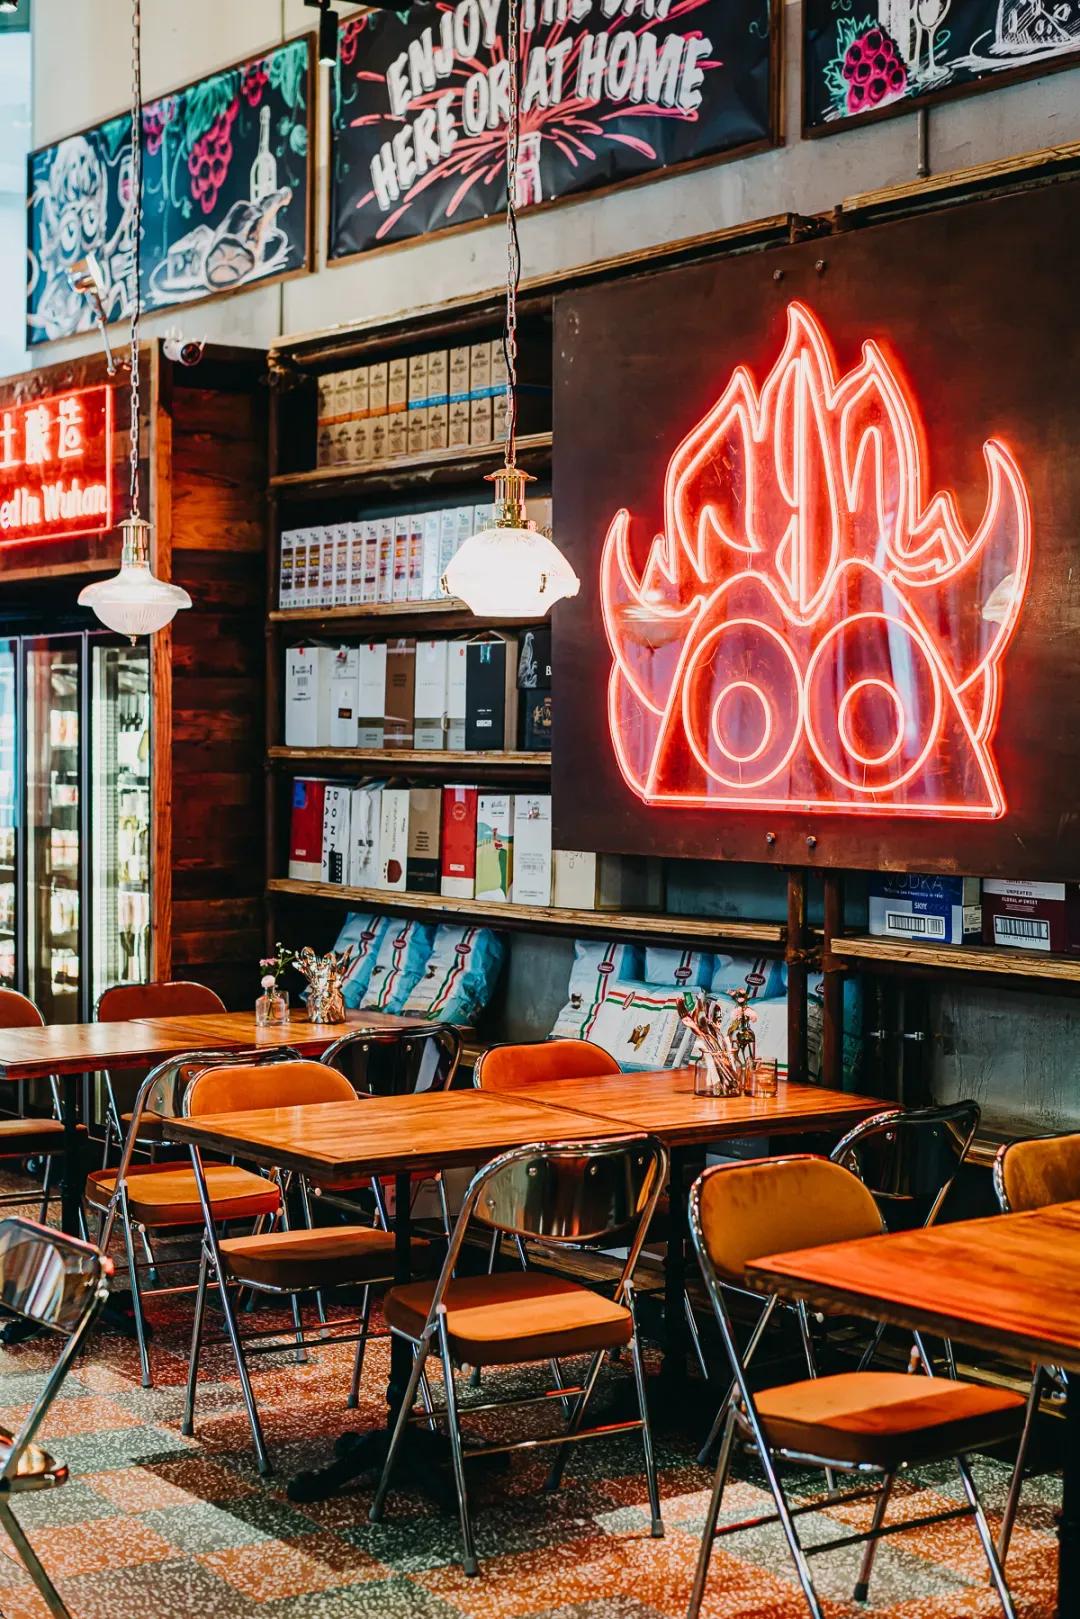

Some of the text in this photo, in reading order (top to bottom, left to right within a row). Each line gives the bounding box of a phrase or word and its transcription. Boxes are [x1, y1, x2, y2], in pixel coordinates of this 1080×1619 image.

[387, 0, 500, 116] ENJOY
[370, 31, 713, 211] HERE OR AT HOME
[41, 478, 107, 522] Wuhan
